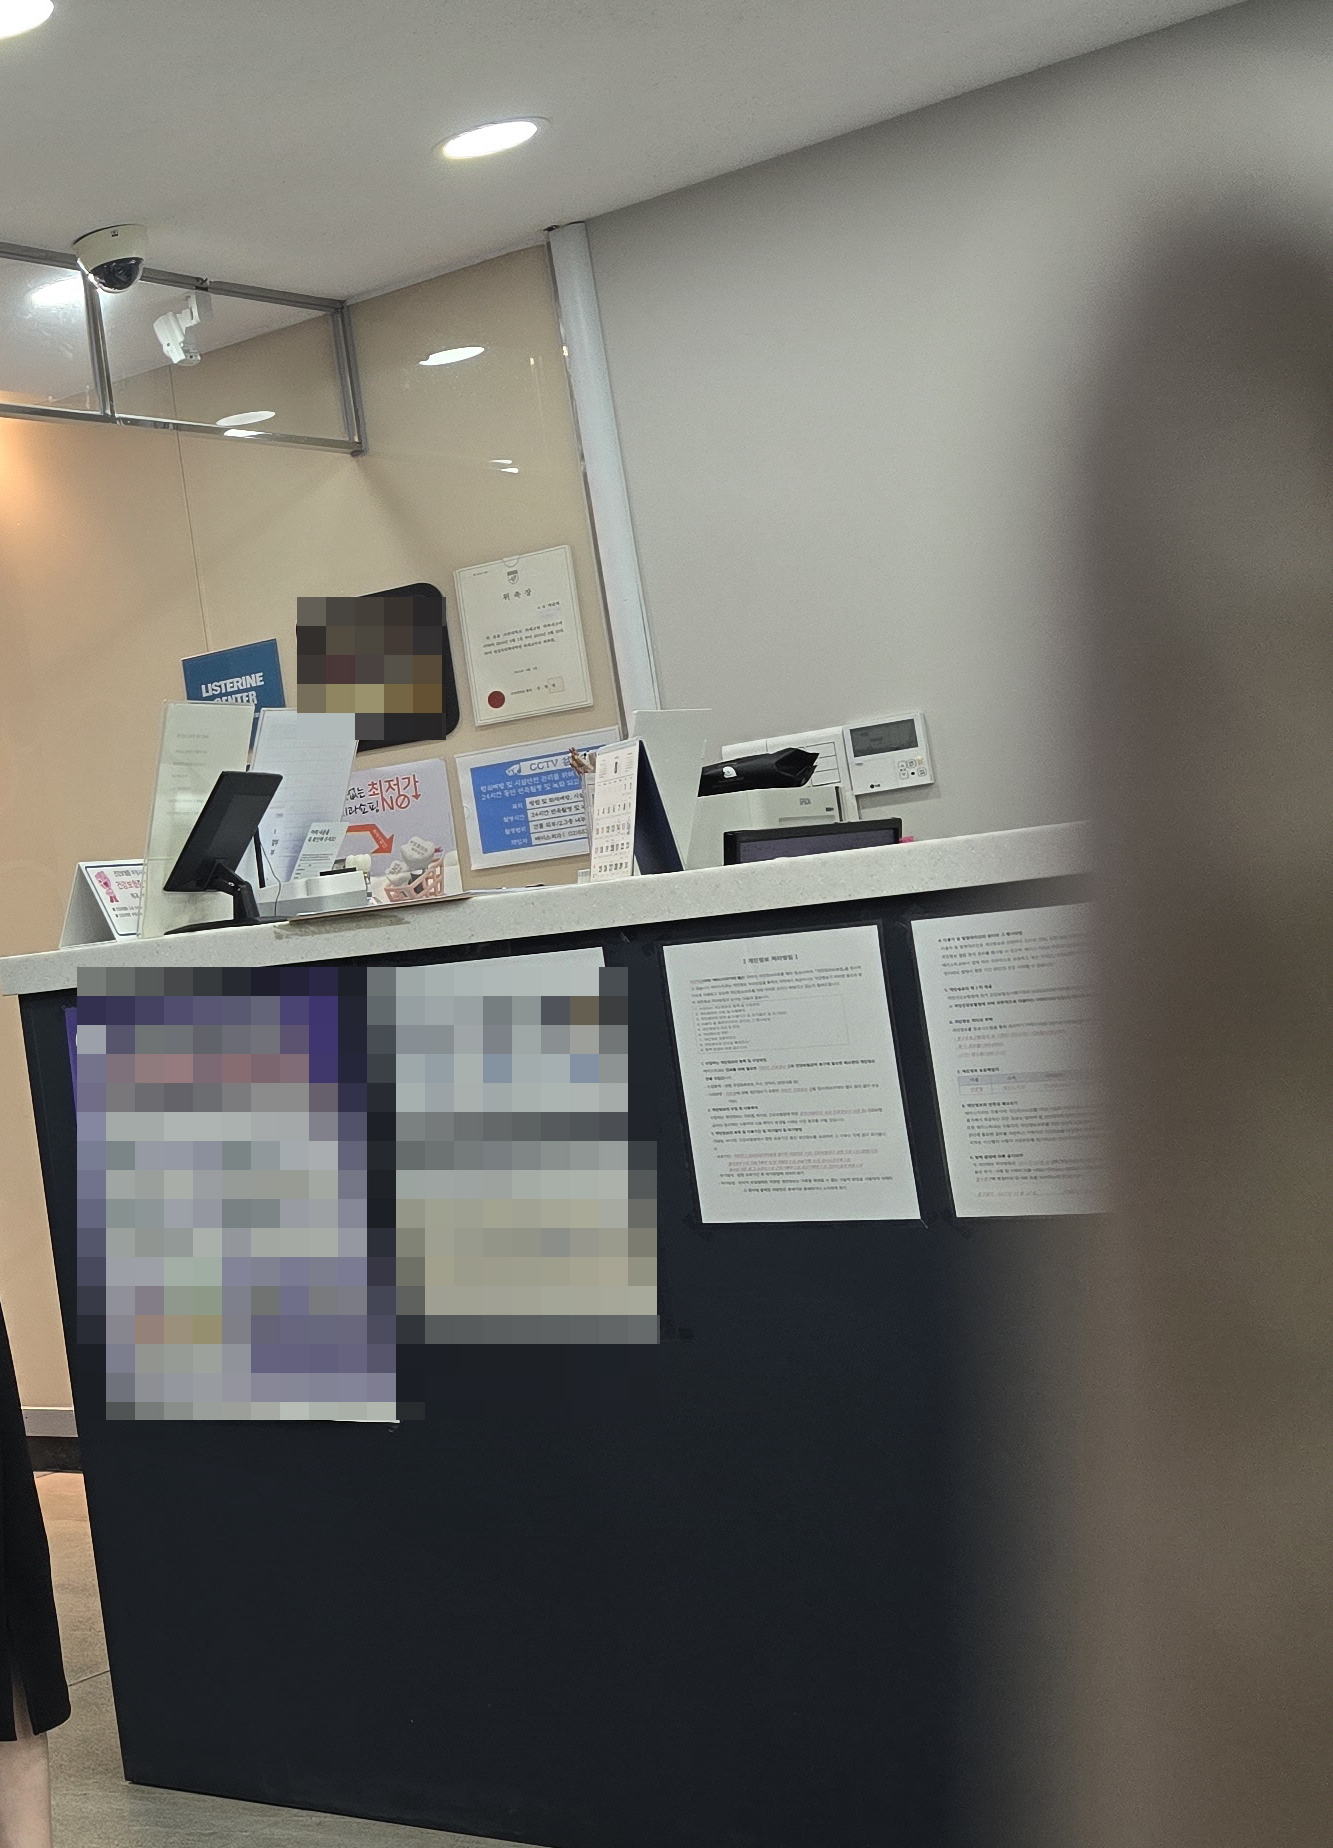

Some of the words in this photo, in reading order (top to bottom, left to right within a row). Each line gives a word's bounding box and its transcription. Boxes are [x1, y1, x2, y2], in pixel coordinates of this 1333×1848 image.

[201, 672, 264, 697] LISTERINE
[529, 759, 558, 772] CCTV
[346, 787, 366, 801] 없는
[368, 774, 419, 799] 최저가
